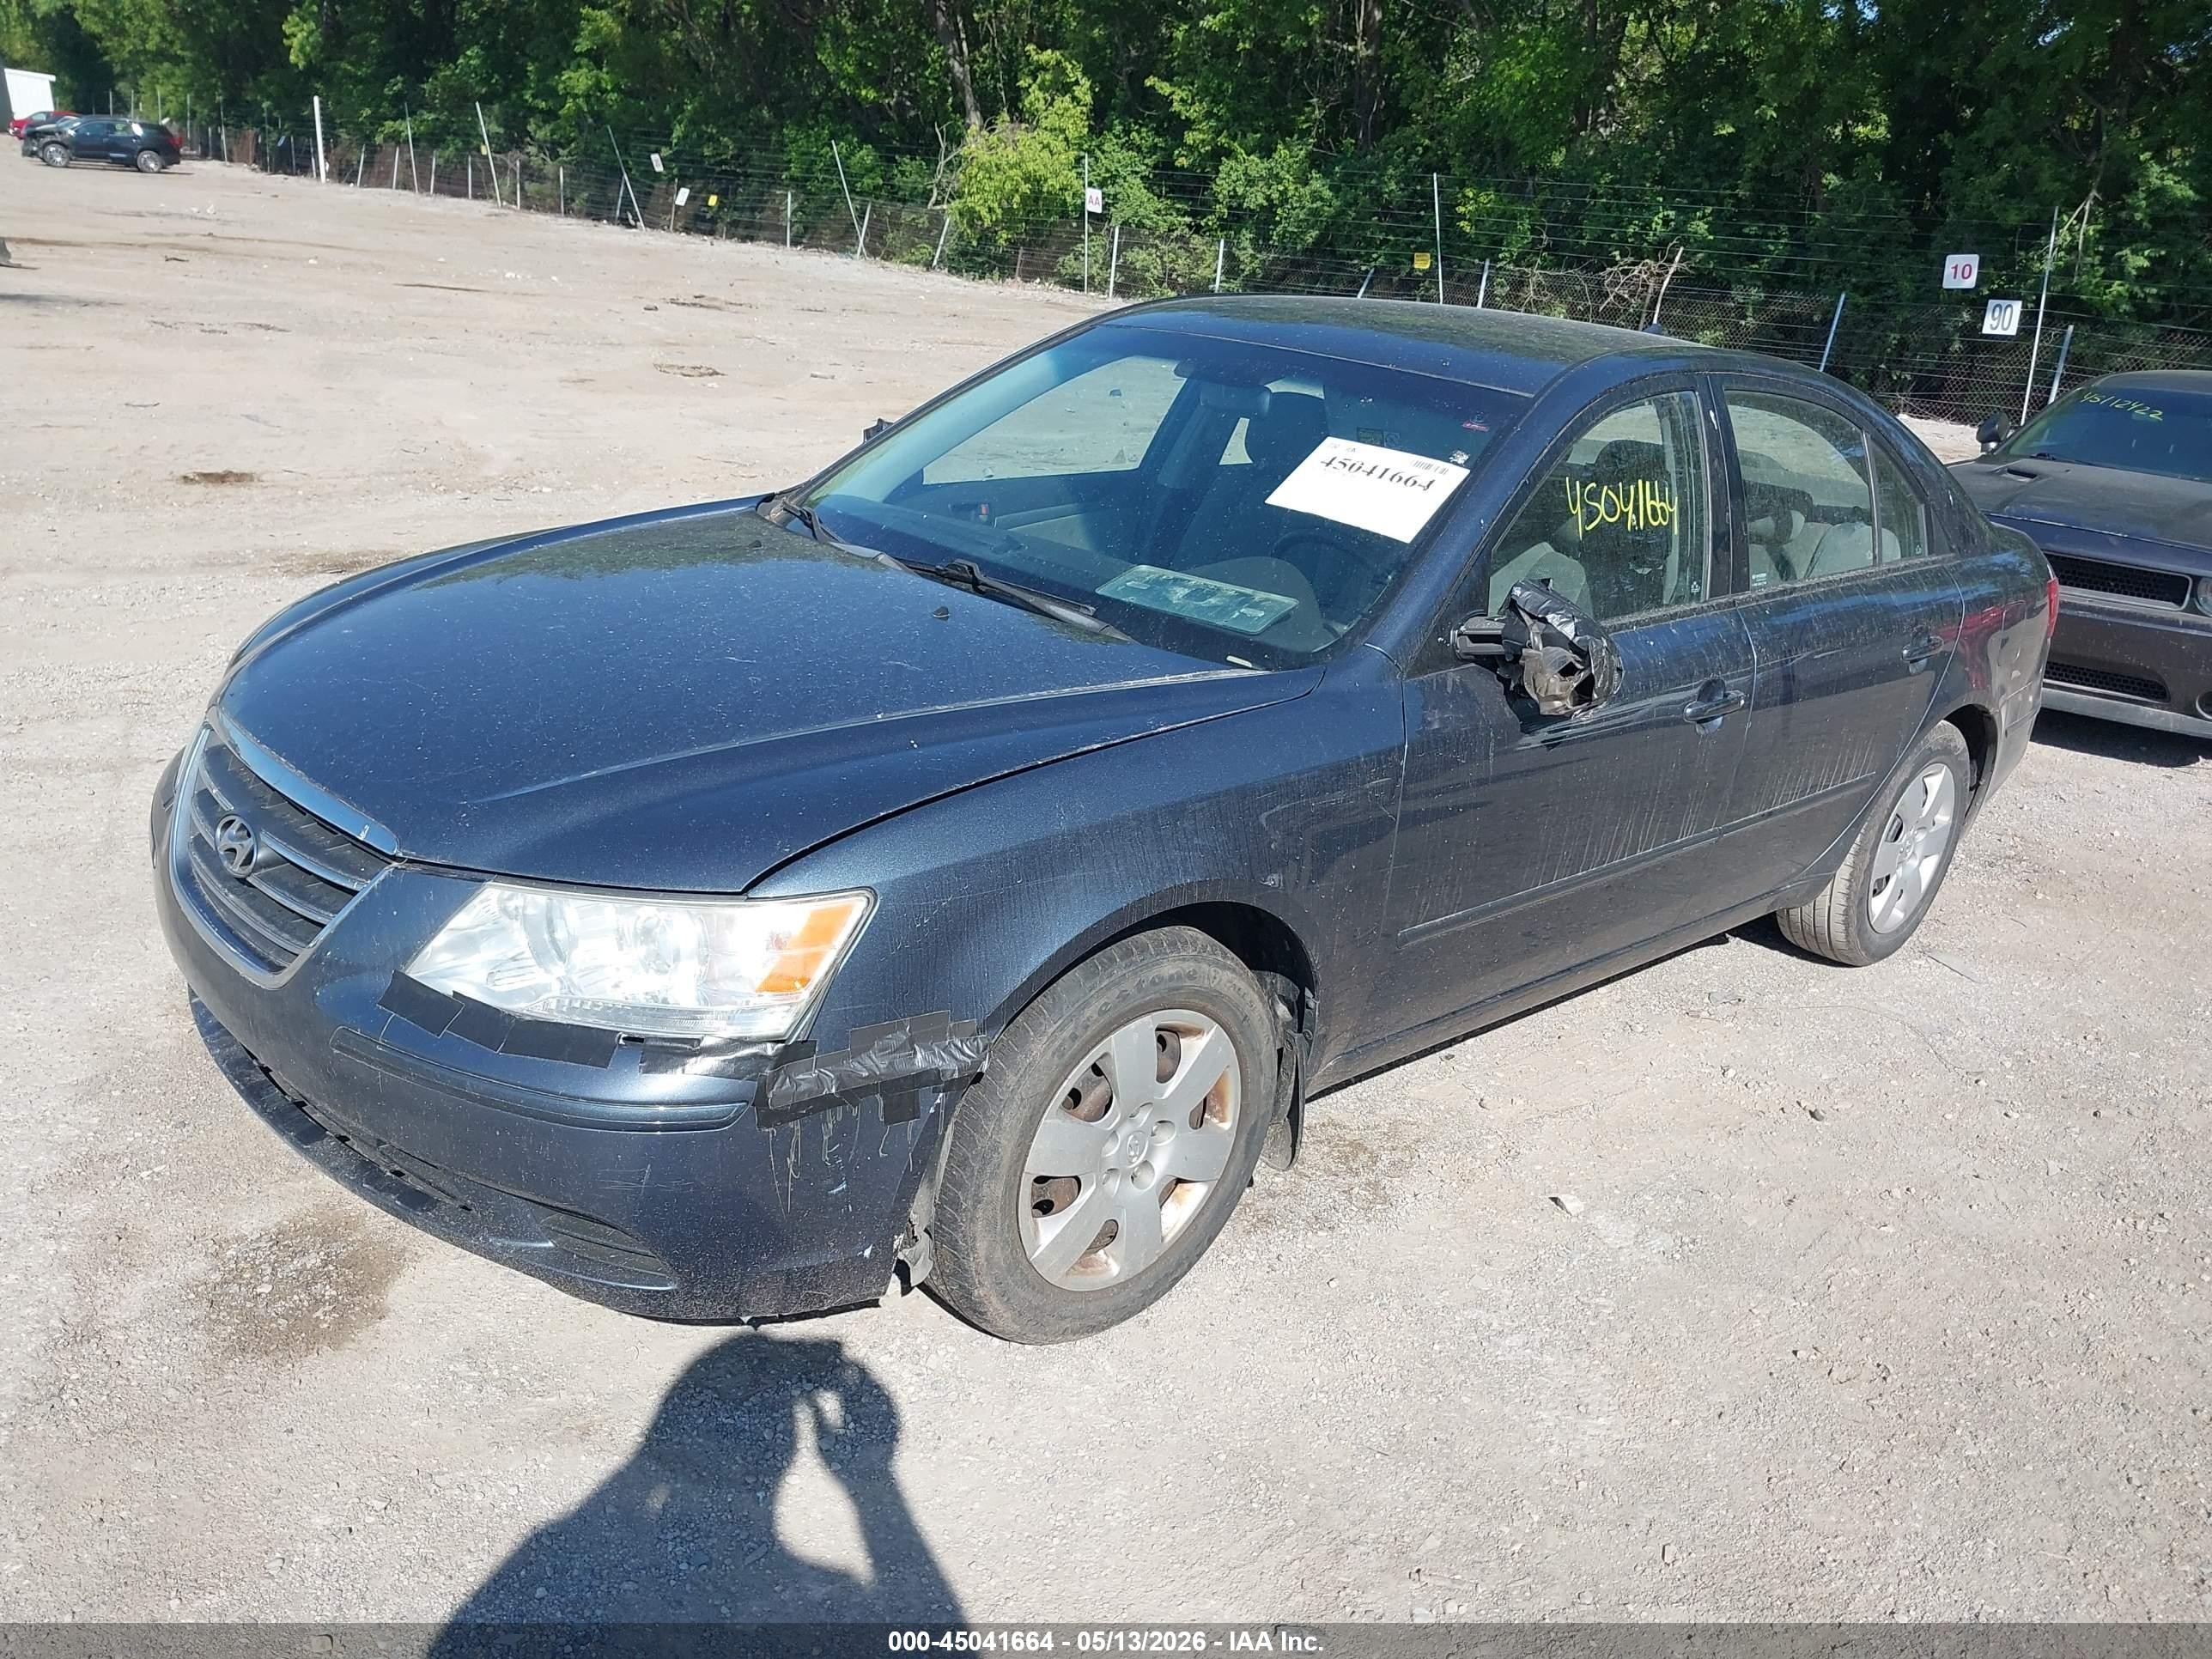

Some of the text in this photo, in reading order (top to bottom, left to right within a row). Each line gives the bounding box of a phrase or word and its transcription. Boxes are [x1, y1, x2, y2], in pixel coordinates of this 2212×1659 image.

[1088, 194, 1100, 206] AA
[1951, 263, 1972, 280] 10
[1989, 303, 2014, 331] 90
[1321, 455, 1436, 492] 45041664
[1565, 476, 1679, 541] 45041664
